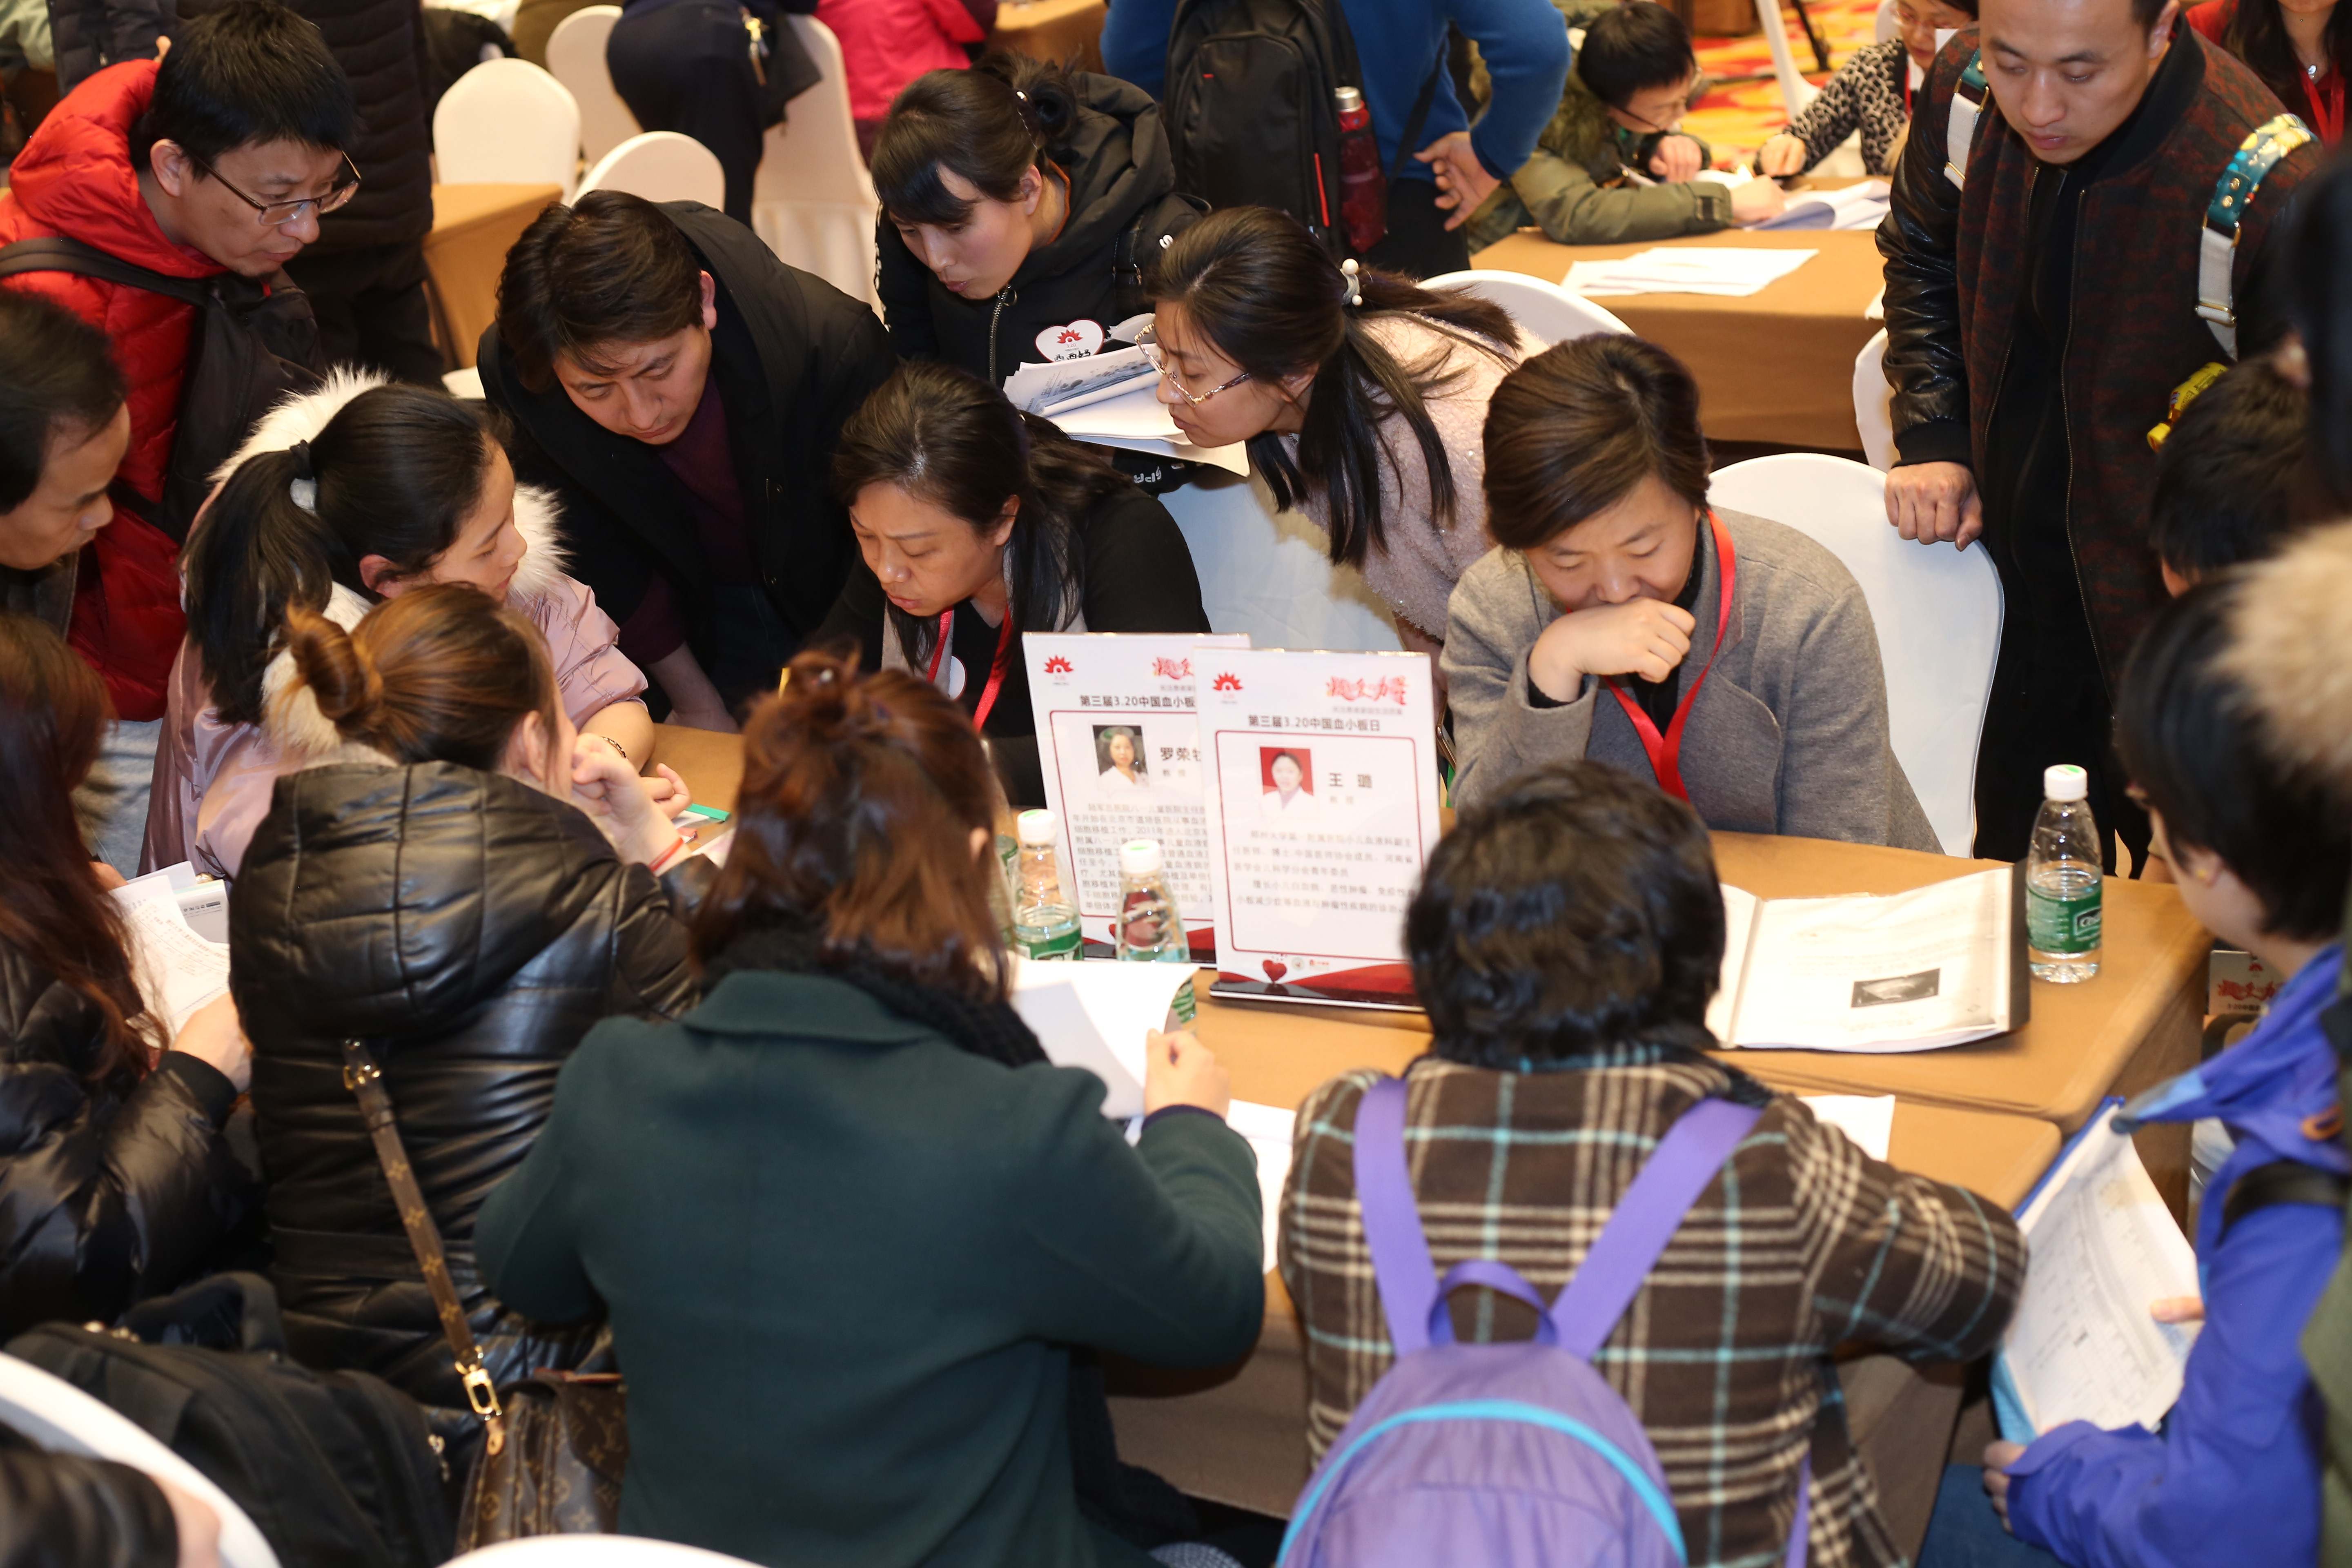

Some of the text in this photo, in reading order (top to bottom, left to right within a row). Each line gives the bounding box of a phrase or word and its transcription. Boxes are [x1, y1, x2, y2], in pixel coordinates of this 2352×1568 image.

[1248, 715, 1380, 732] 第三届3.20中国血小板日
